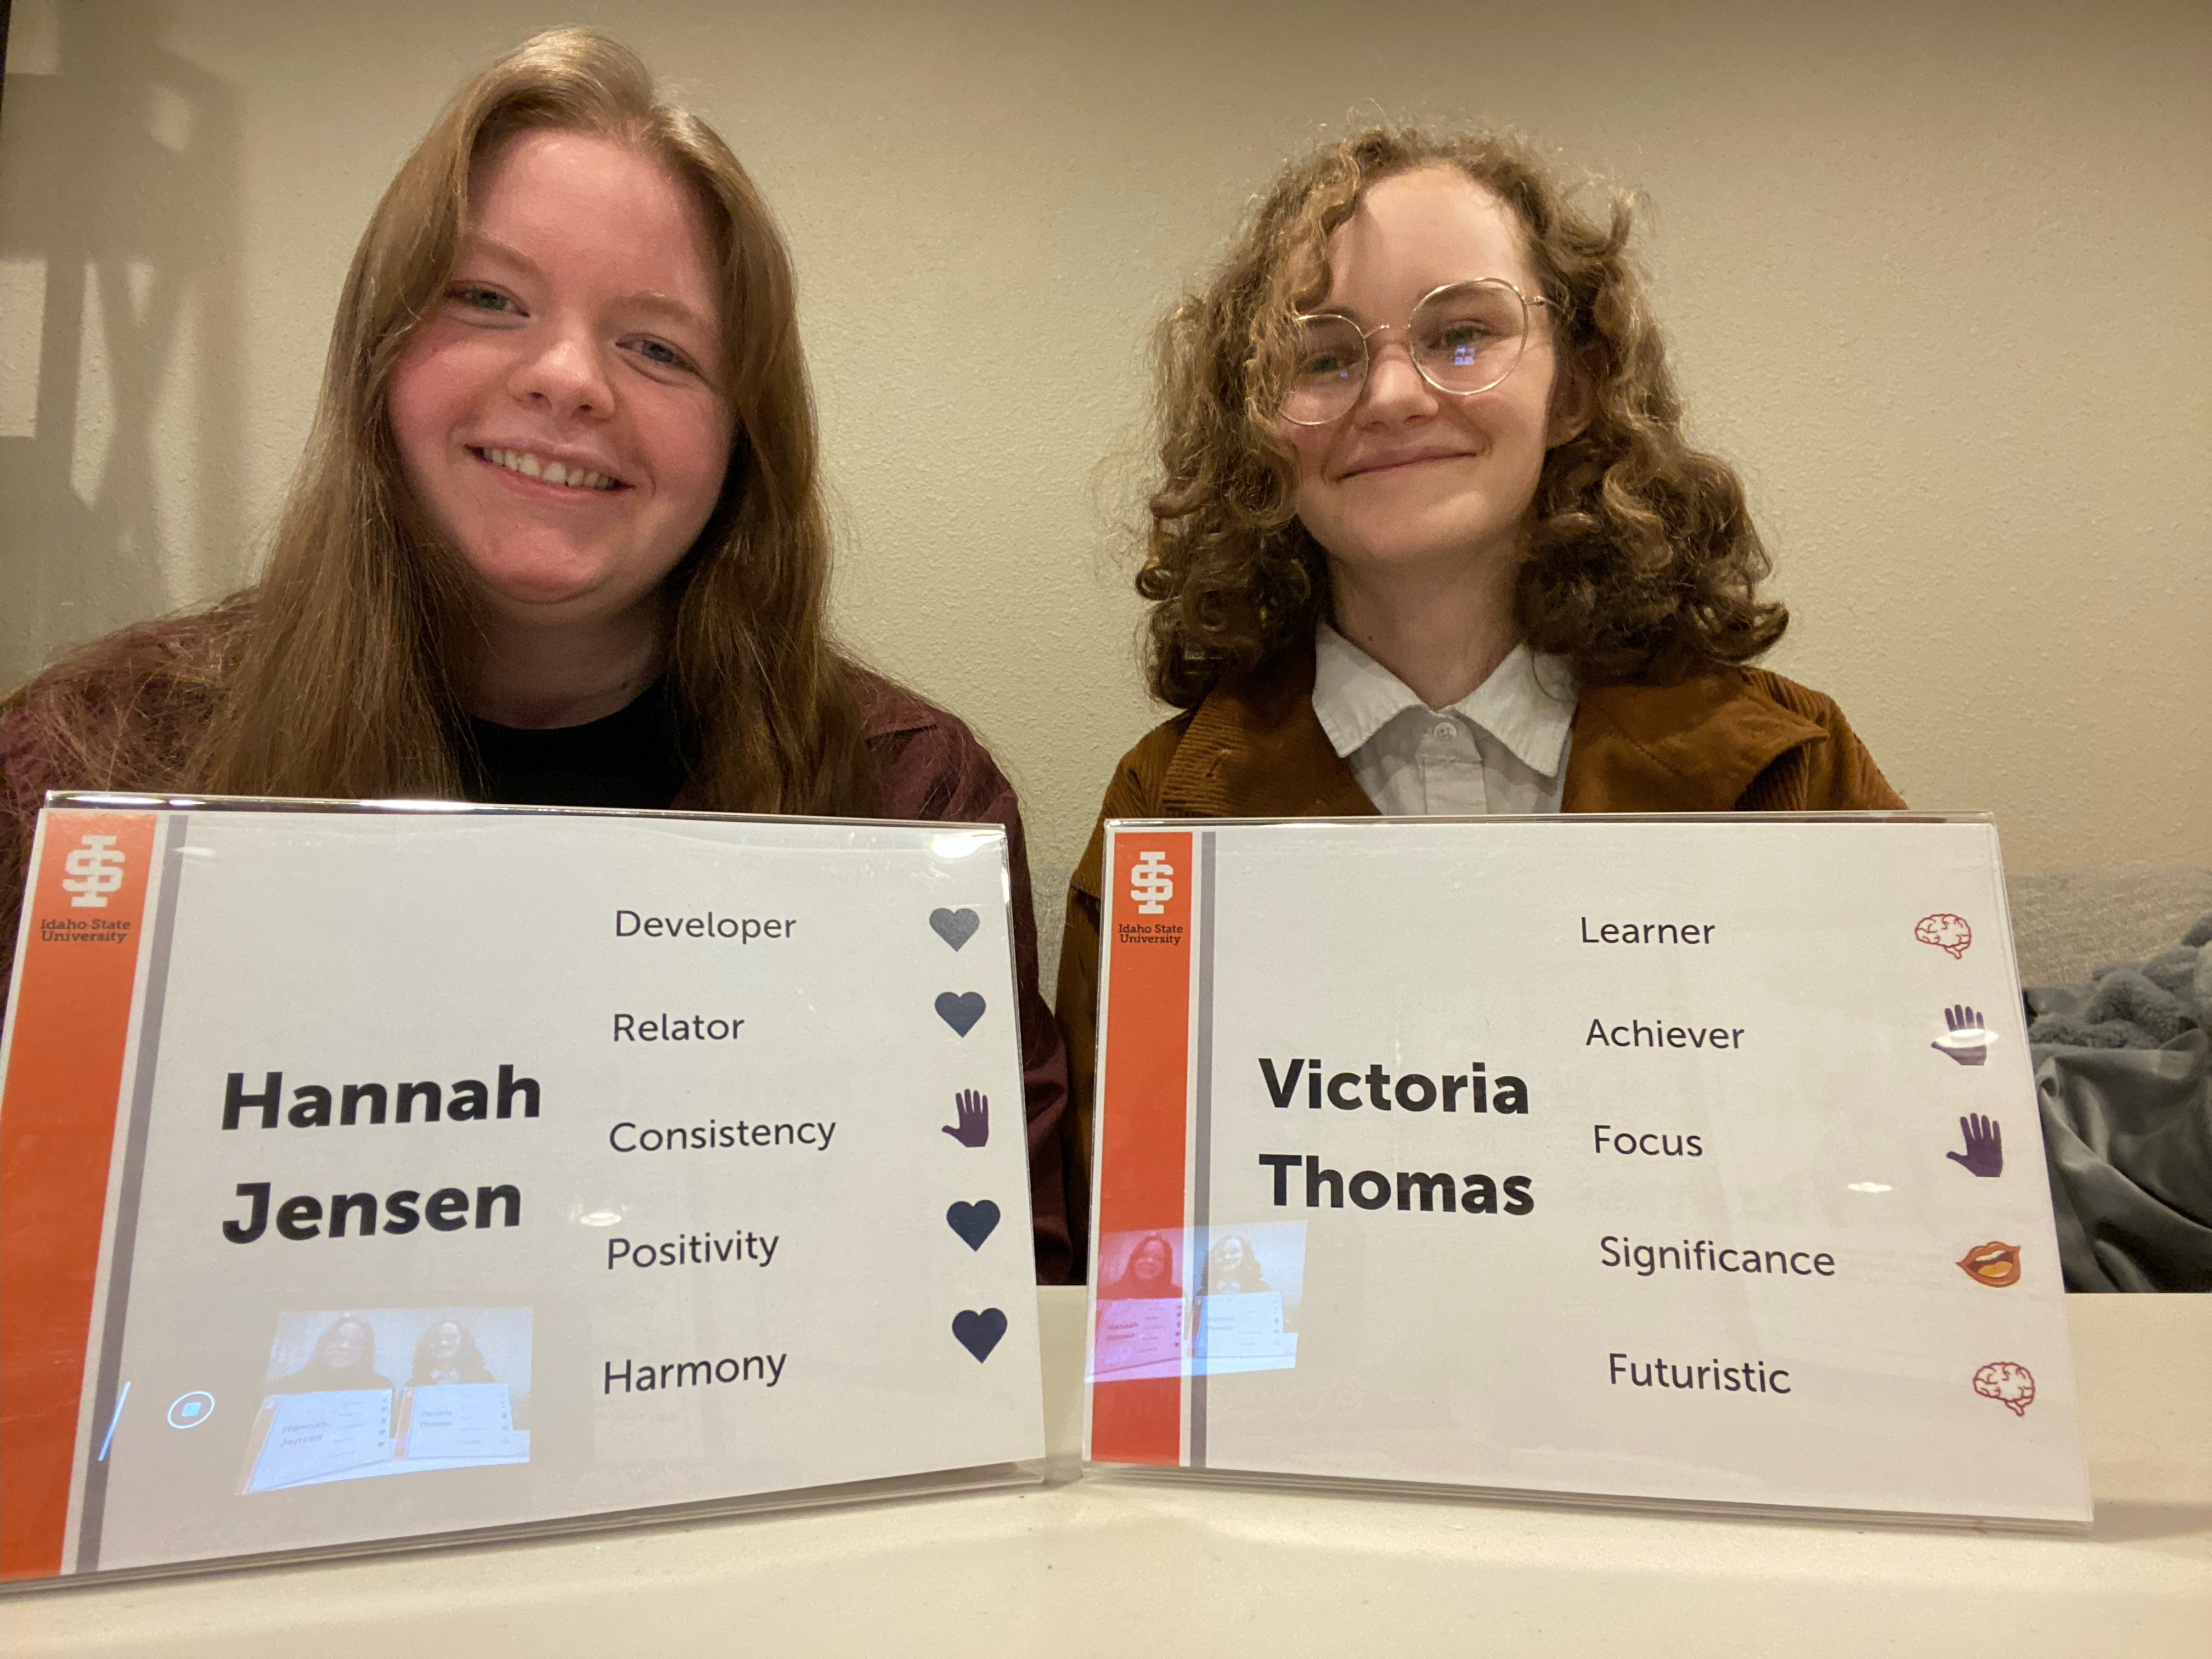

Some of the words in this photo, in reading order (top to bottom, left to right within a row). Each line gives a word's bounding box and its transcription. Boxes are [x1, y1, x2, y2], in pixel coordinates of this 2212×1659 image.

[41, 919, 87, 930] Idaho
[91, 919, 131, 930] State
[41, 931, 128, 944] University
[615, 909, 797, 946] Developer
[1119, 924, 1152, 933] Idaho
[1155, 924, 1183, 933] State
[1120, 934, 1181, 945] University
[1581, 916, 1716, 945] Learner
[613, 1012, 746, 1043] Relator
[1585, 1018, 1746, 1050] Achiever
[221, 1063, 541, 1131] Hannah
[1257, 1057, 1530, 1115] Victoria
[608, 1118, 837, 1154] Consistency
[1593, 1124, 1704, 1158] Focus
[1257, 1153, 1535, 1217] Thomas
[221, 1181, 522, 1245] Jensen
[607, 1229, 780, 1271] Positivity
[1599, 1234, 1836, 1278] Significance
[603, 1352, 788, 1396] Harmony
[1609, 1352, 1792, 1395] Futuristic
